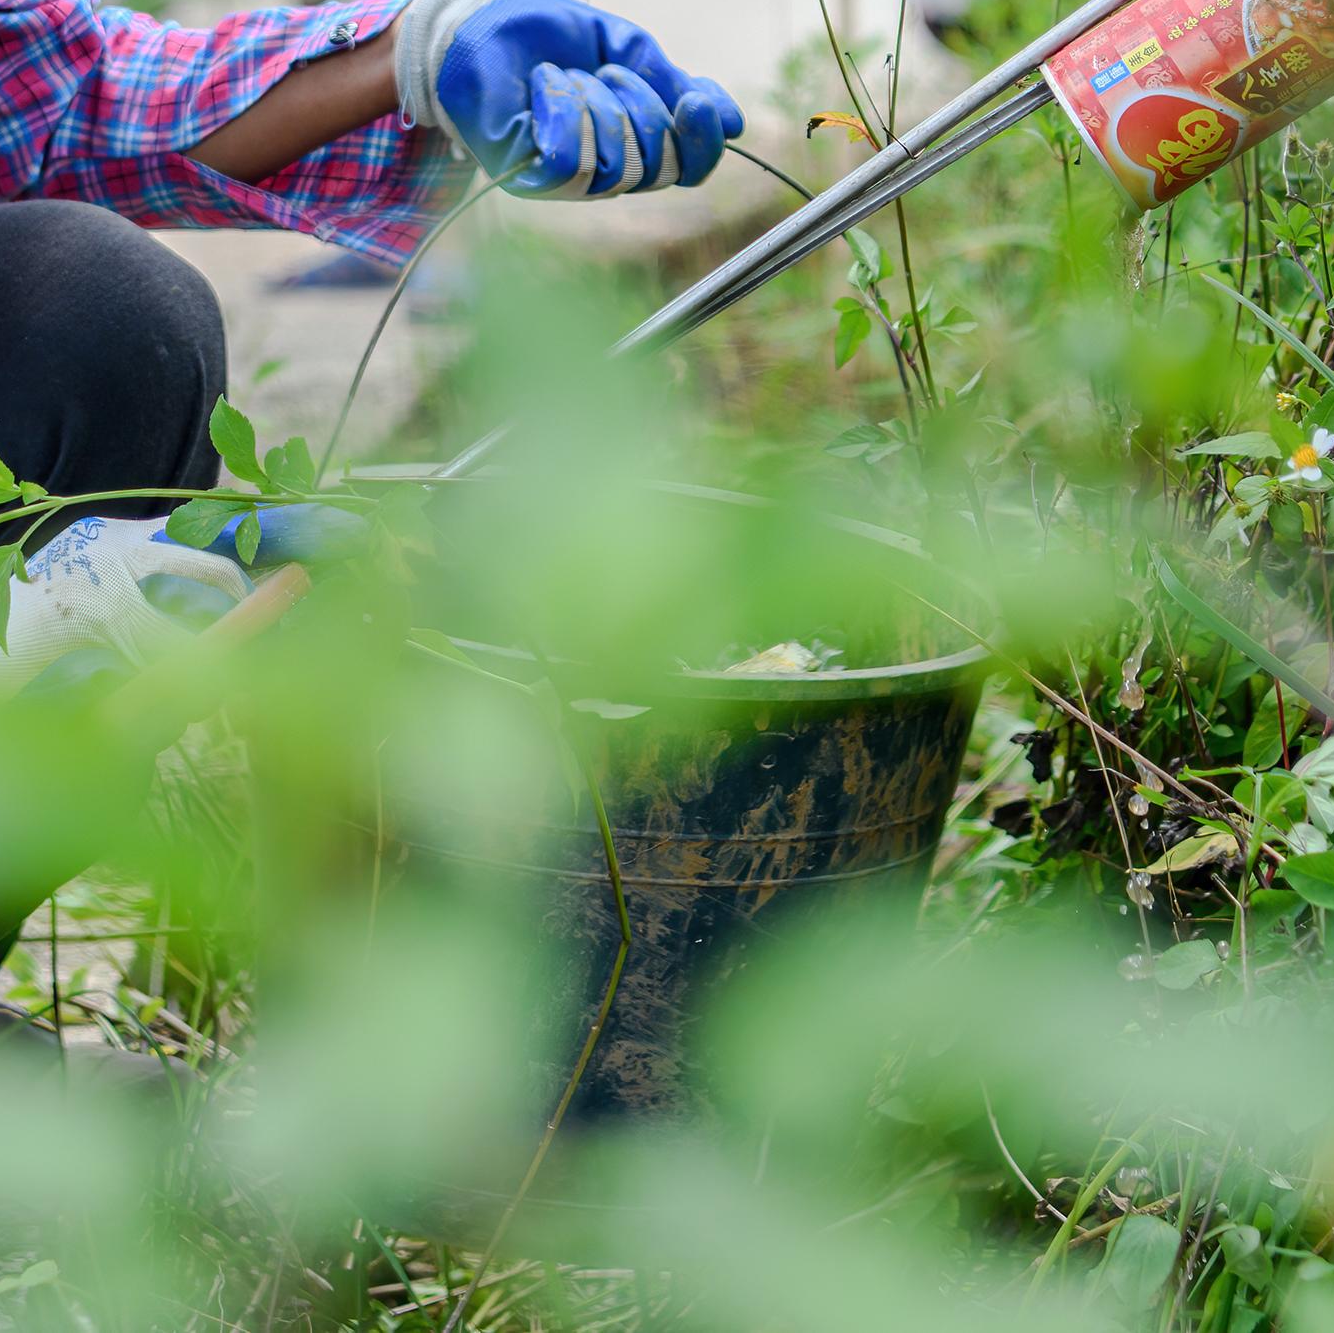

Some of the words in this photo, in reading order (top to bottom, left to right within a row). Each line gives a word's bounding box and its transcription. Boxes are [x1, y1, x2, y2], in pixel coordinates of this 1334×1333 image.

[1094, 61, 1128, 92] 健康
[1128, 40, 1159, 68] 美食
[1241, 45, 1312, 102] 八宝粥
[1145, 108, 1232, 187] 福
